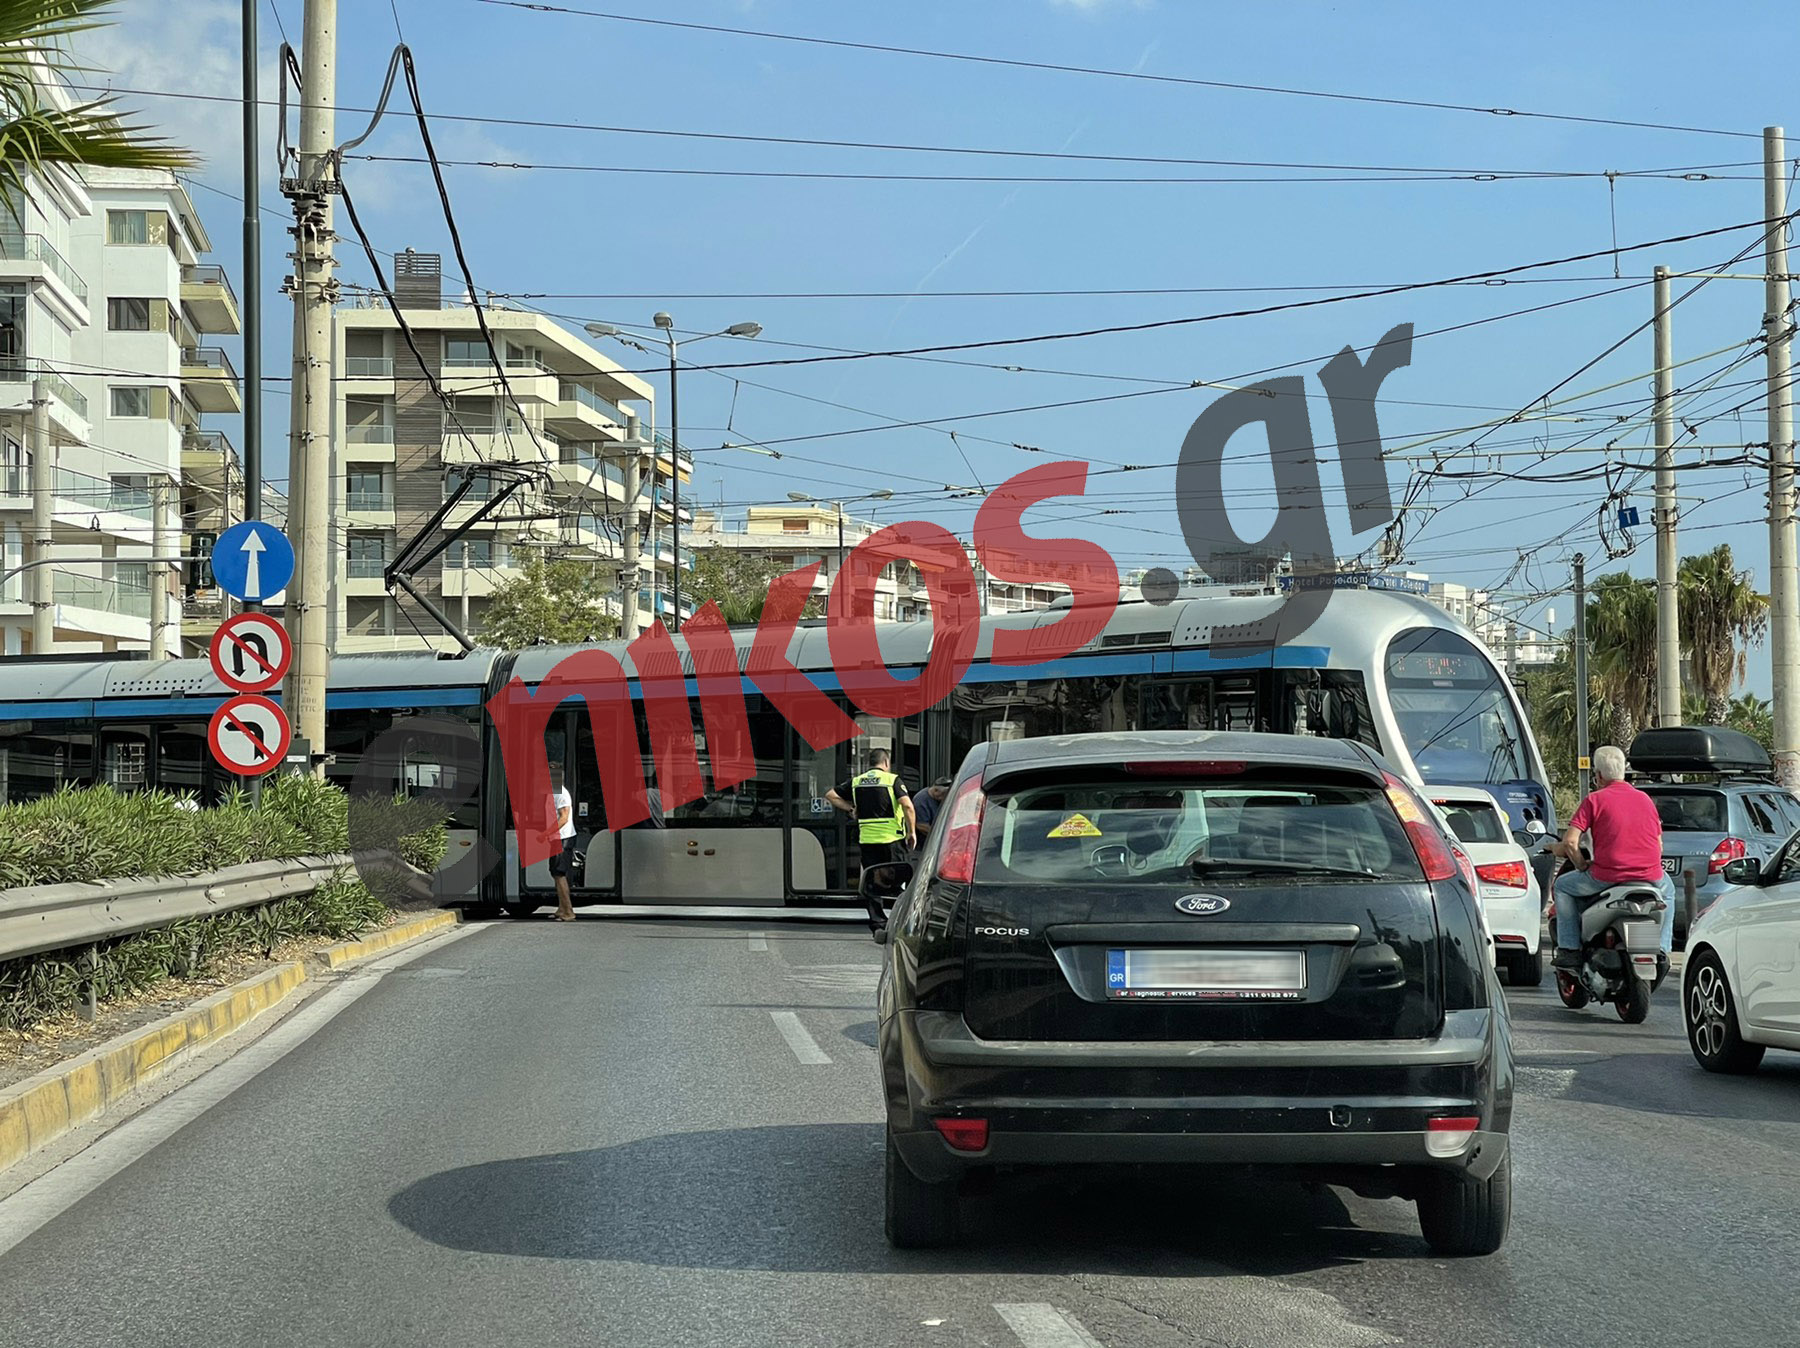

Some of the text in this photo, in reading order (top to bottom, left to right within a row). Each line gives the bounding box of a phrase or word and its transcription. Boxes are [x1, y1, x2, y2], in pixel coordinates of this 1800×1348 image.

[1624, 510, 1632, 525] T
[1288, 575, 1314, 587] Hotel
[1188, 897, 1217, 911] Ford
[974, 926, 1030, 937] FOCUS
[1109, 973, 1125, 983] GR
